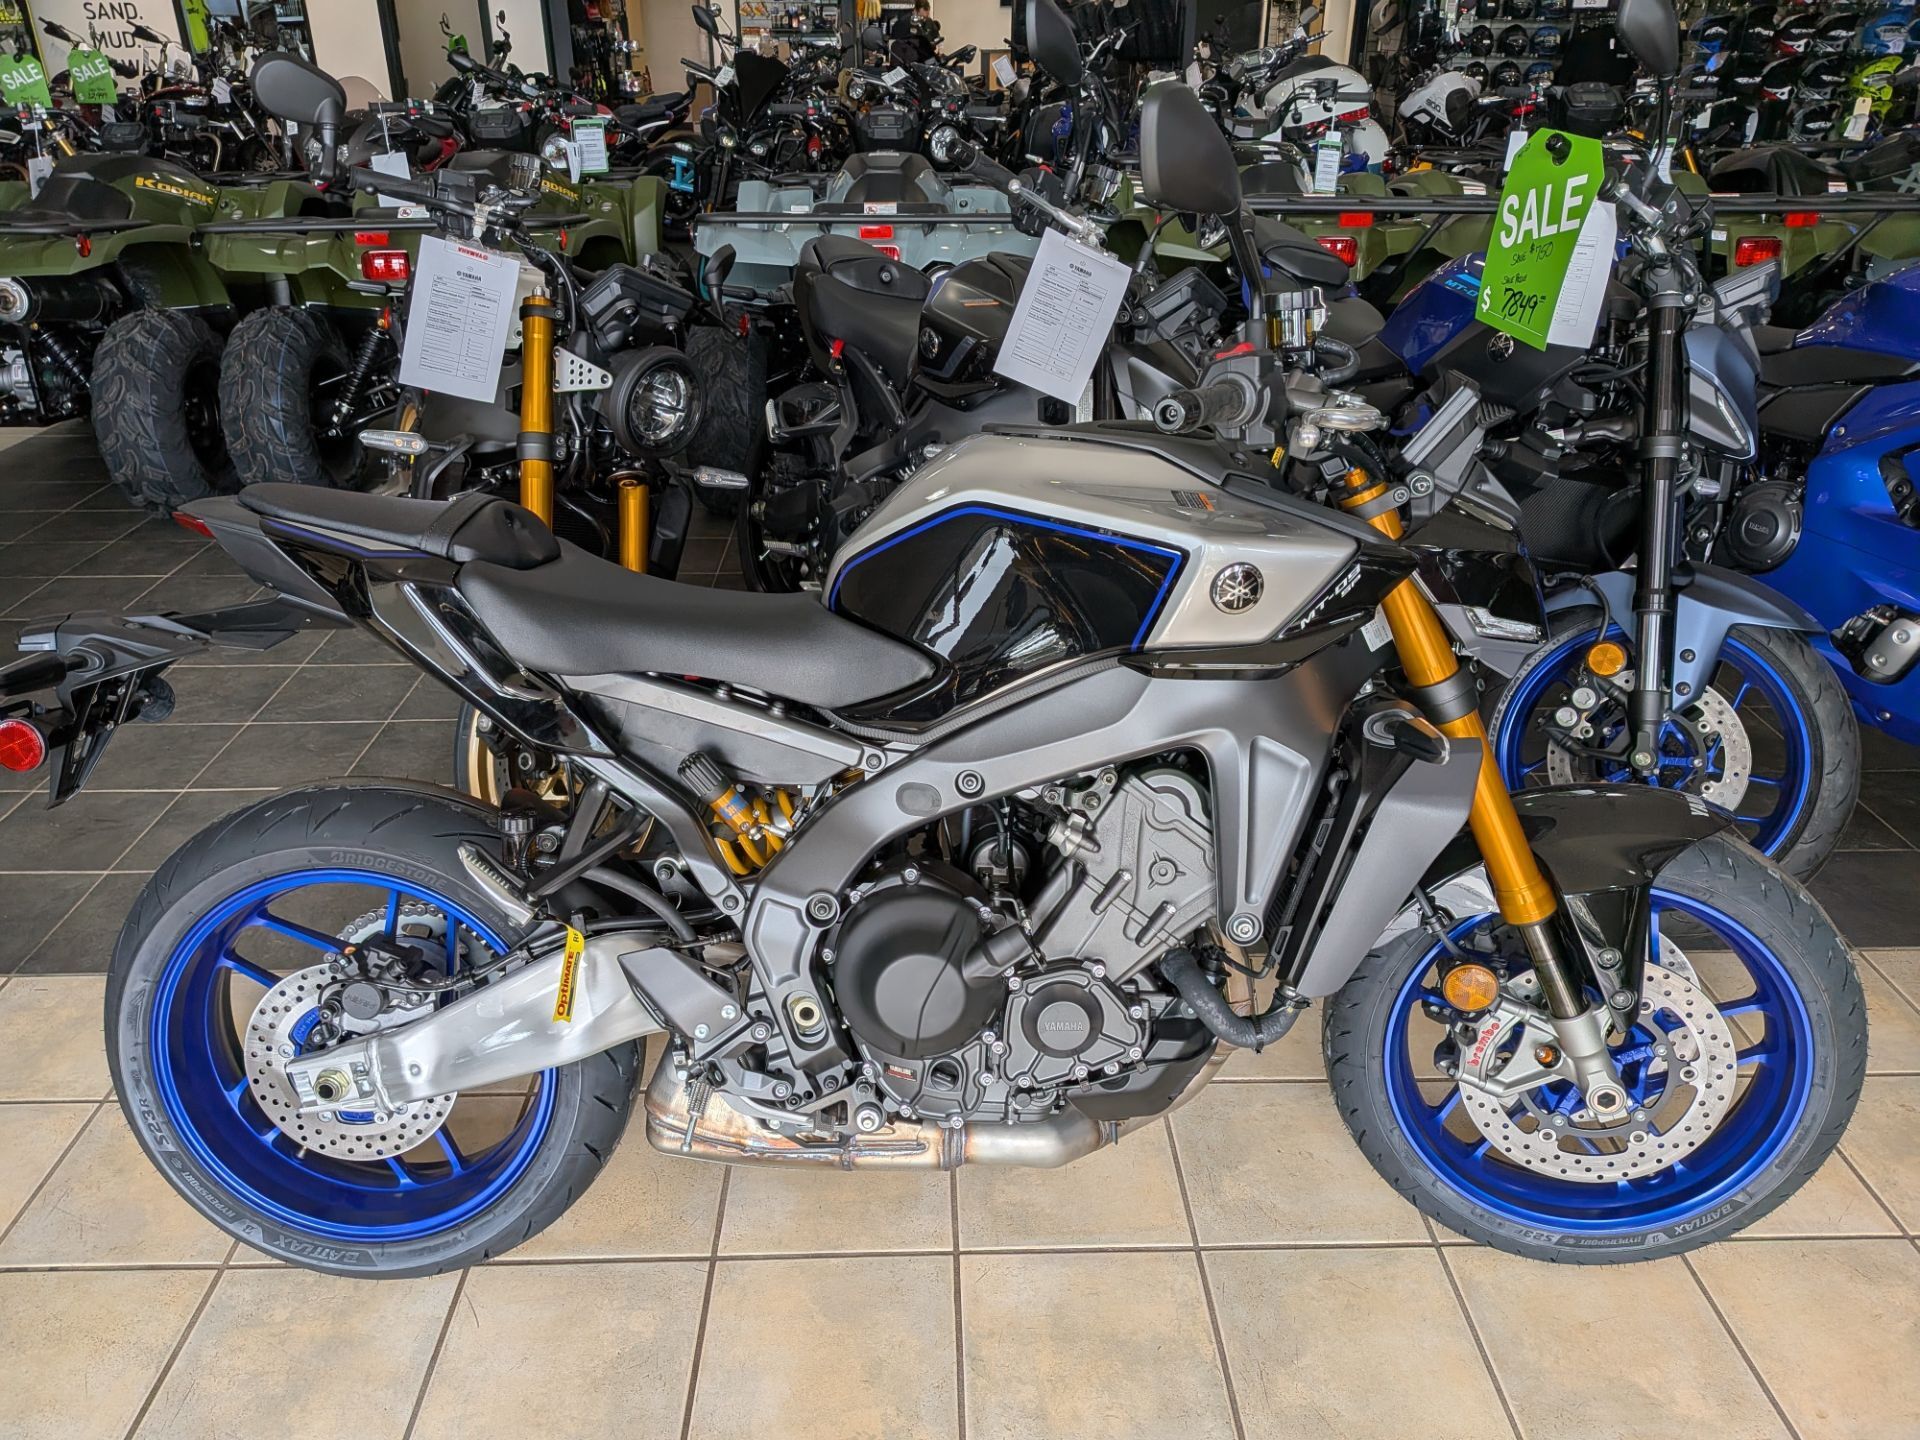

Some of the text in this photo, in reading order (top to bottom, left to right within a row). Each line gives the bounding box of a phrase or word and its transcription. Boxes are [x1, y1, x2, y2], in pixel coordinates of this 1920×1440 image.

[83, 2, 143, 20] SAND.
[92, 31, 142, 49] MUD.
[2, 63, 43, 90] SALE
[72, 58, 110, 82] SALE
[135, 176, 214, 205] KODIAK
[541, 179, 579, 201] ODIAK
[1500, 174, 1589, 248] SALE
[461, 271, 482, 282] YAMAHA
[1074, 264, 1092, 277] YAMAHA
[1444, 279, 1479, 297] MT-0
[1481, 285, 1492, 313] $
[1300, 563, 1361, 631] MT-09
[329, 850, 448, 888] BRIDGESTONE
[556, 950, 575, 1017] OptiMATE
[1044, 1021, 1084, 1032] YAMAHA
[1466, 1022, 1500, 1066] brembo
[181, 1171, 237, 1219] HYPERSPORT
[1673, 1202, 1733, 1237] BATTLAX
[272, 1233, 361, 1264] BATTLAX
